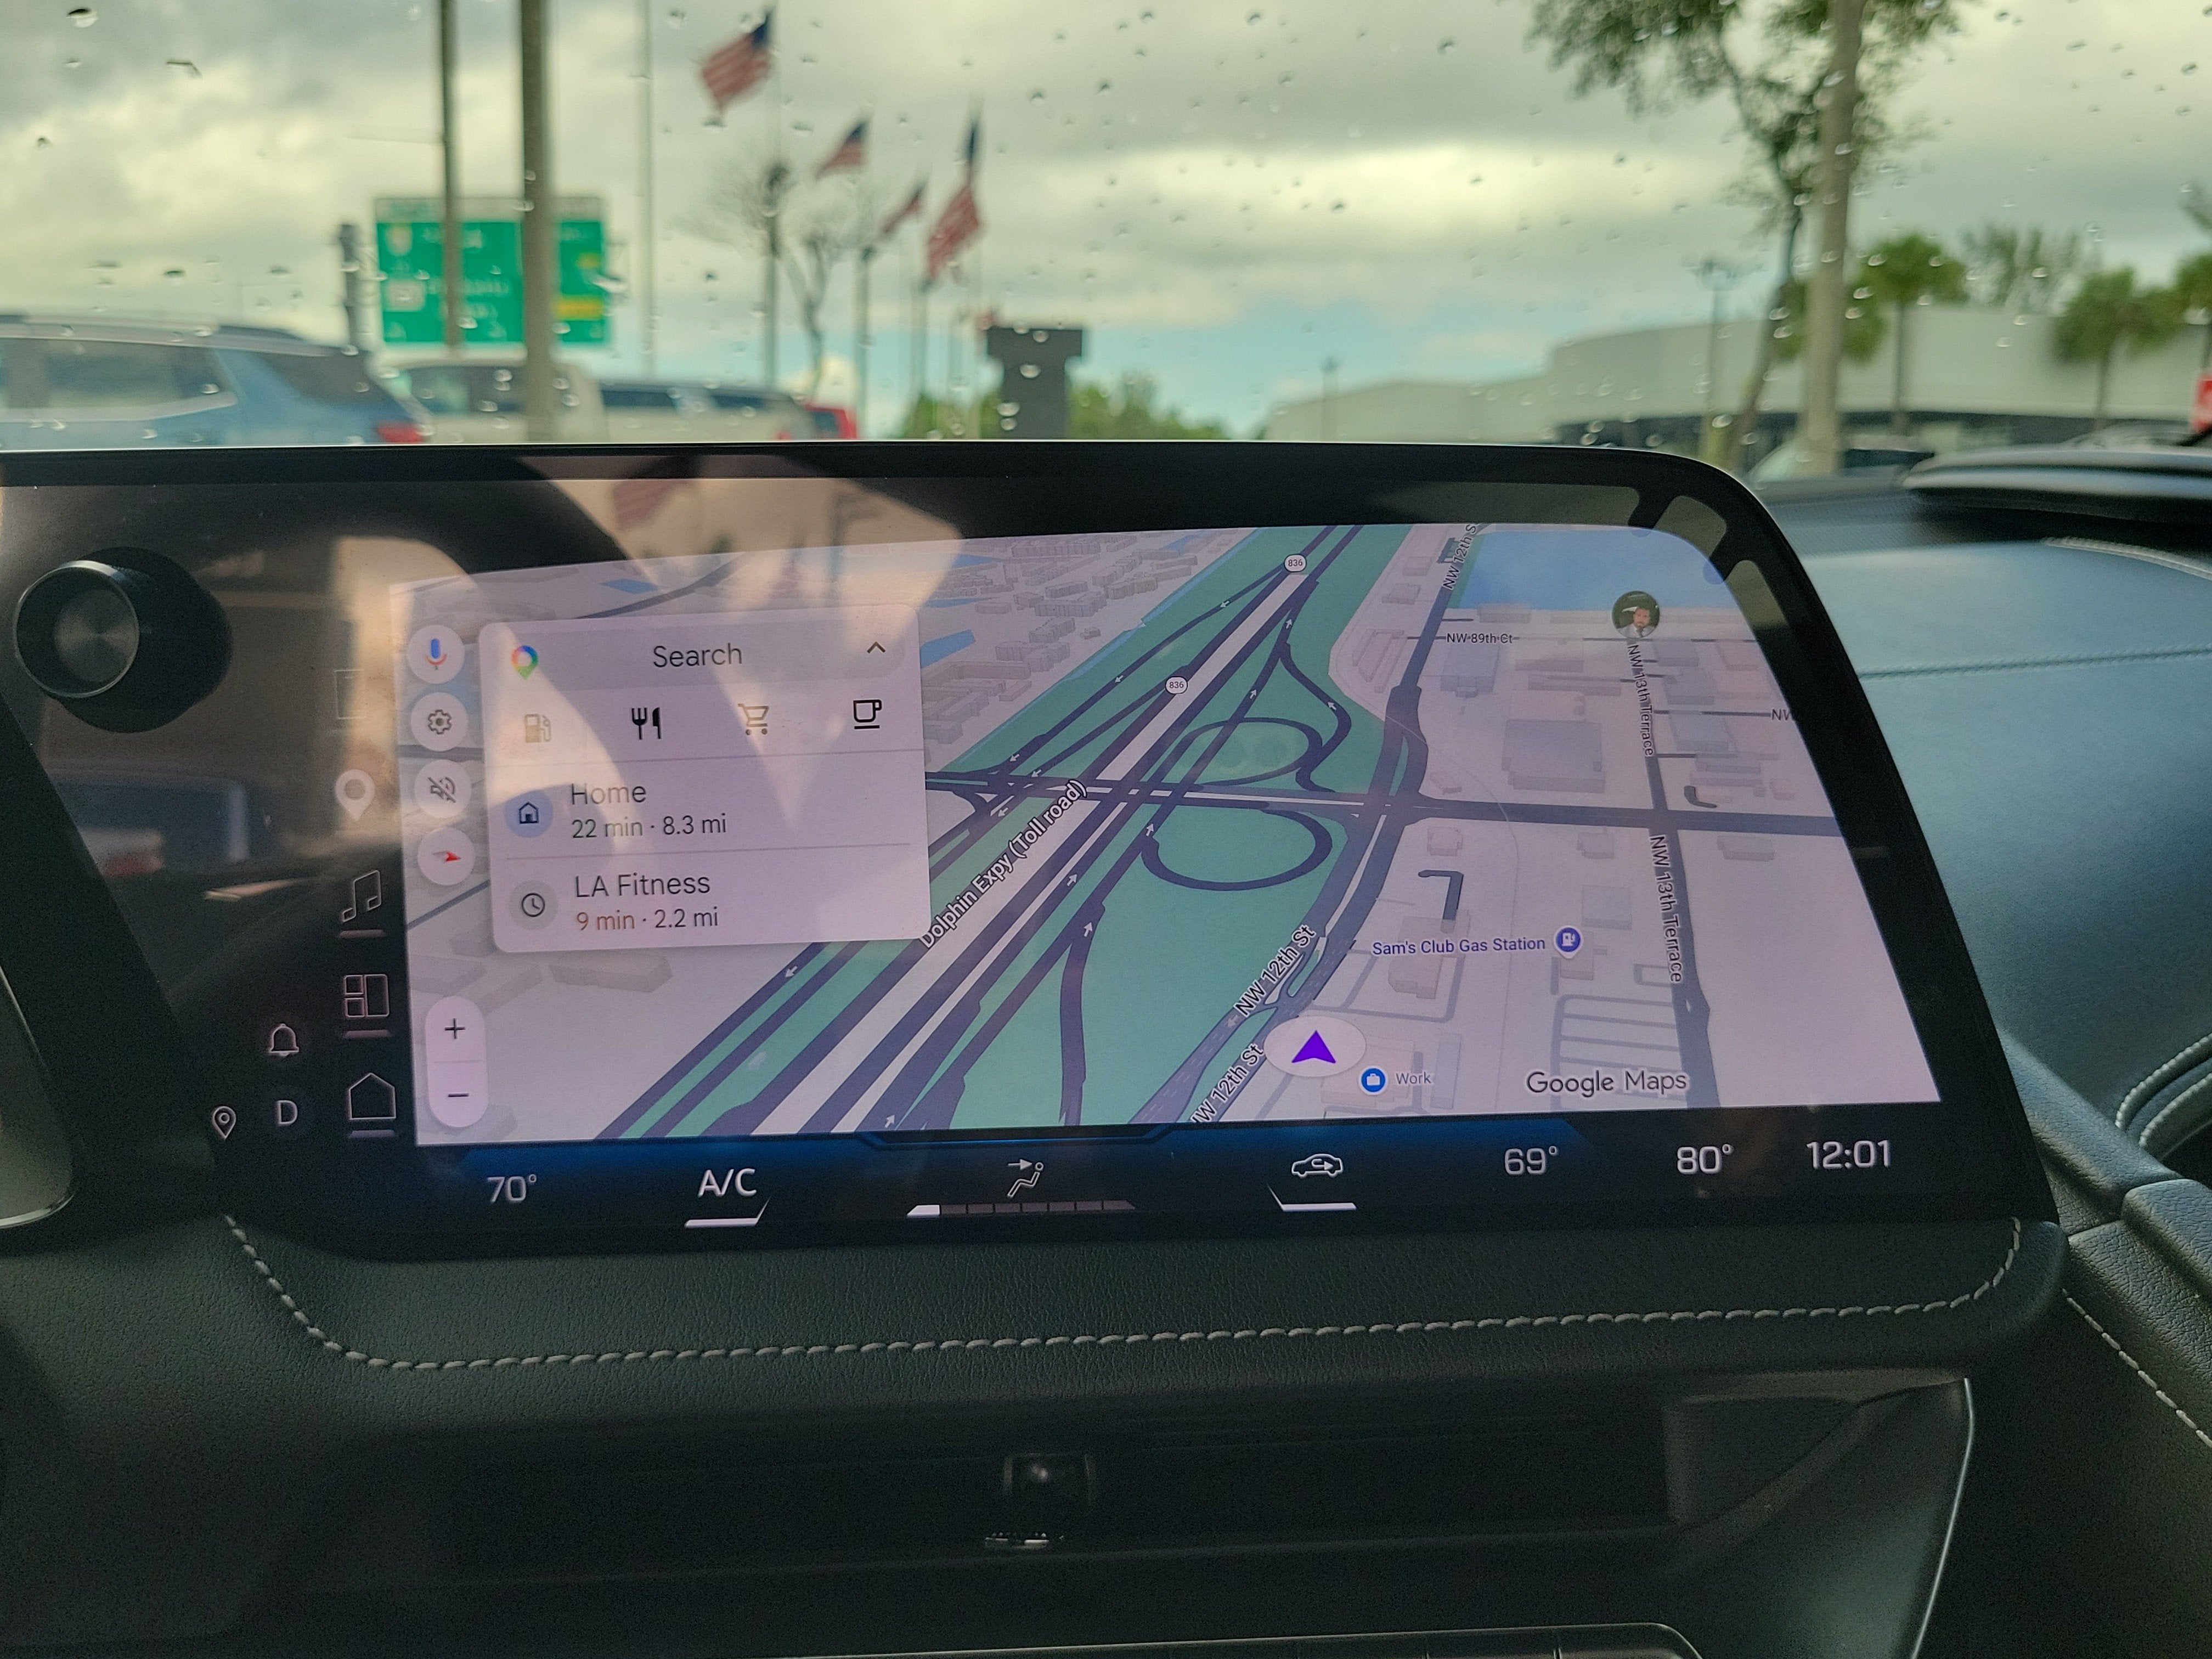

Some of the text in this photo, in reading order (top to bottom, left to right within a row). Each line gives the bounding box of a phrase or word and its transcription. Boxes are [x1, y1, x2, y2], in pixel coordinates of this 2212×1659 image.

[1288, 559, 1303, 567] 836
[1443, 524, 1477, 589] NW 12th S
[1447, 633, 1513, 644] NW 89th Ct
[653, 642, 742, 668] Search
[1169, 681, 1184, 689] 836
[1628, 645, 1654, 757] NW 13th Terrace
[571, 783, 646, 805] Home
[572, 812, 726, 838] 22 min 8.3 mi
[919, 780, 1087, 948] Dolphin Expy (Toll road)
[575, 873, 710, 898] LA Fitness
[577, 906, 719, 930] 9 min 2.2 mi
[1650, 836, 1682, 983] NW 13th Terrace
[1373, 938, 1545, 955] Sam's Club Gas Station
[1235, 925, 1315, 1015] NW 12th St
[1212, 1066, 1247, 1101] 12th
[1242, 1044, 1263, 1065] St
[1396, 1071, 1431, 1086] Work
[1526, 1070, 1688, 1097] Google Maps
[277, 1100, 298, 1126] D
[1807, 1139, 1891, 1170] 12:01
[698, 1168, 758, 1198] A/C
